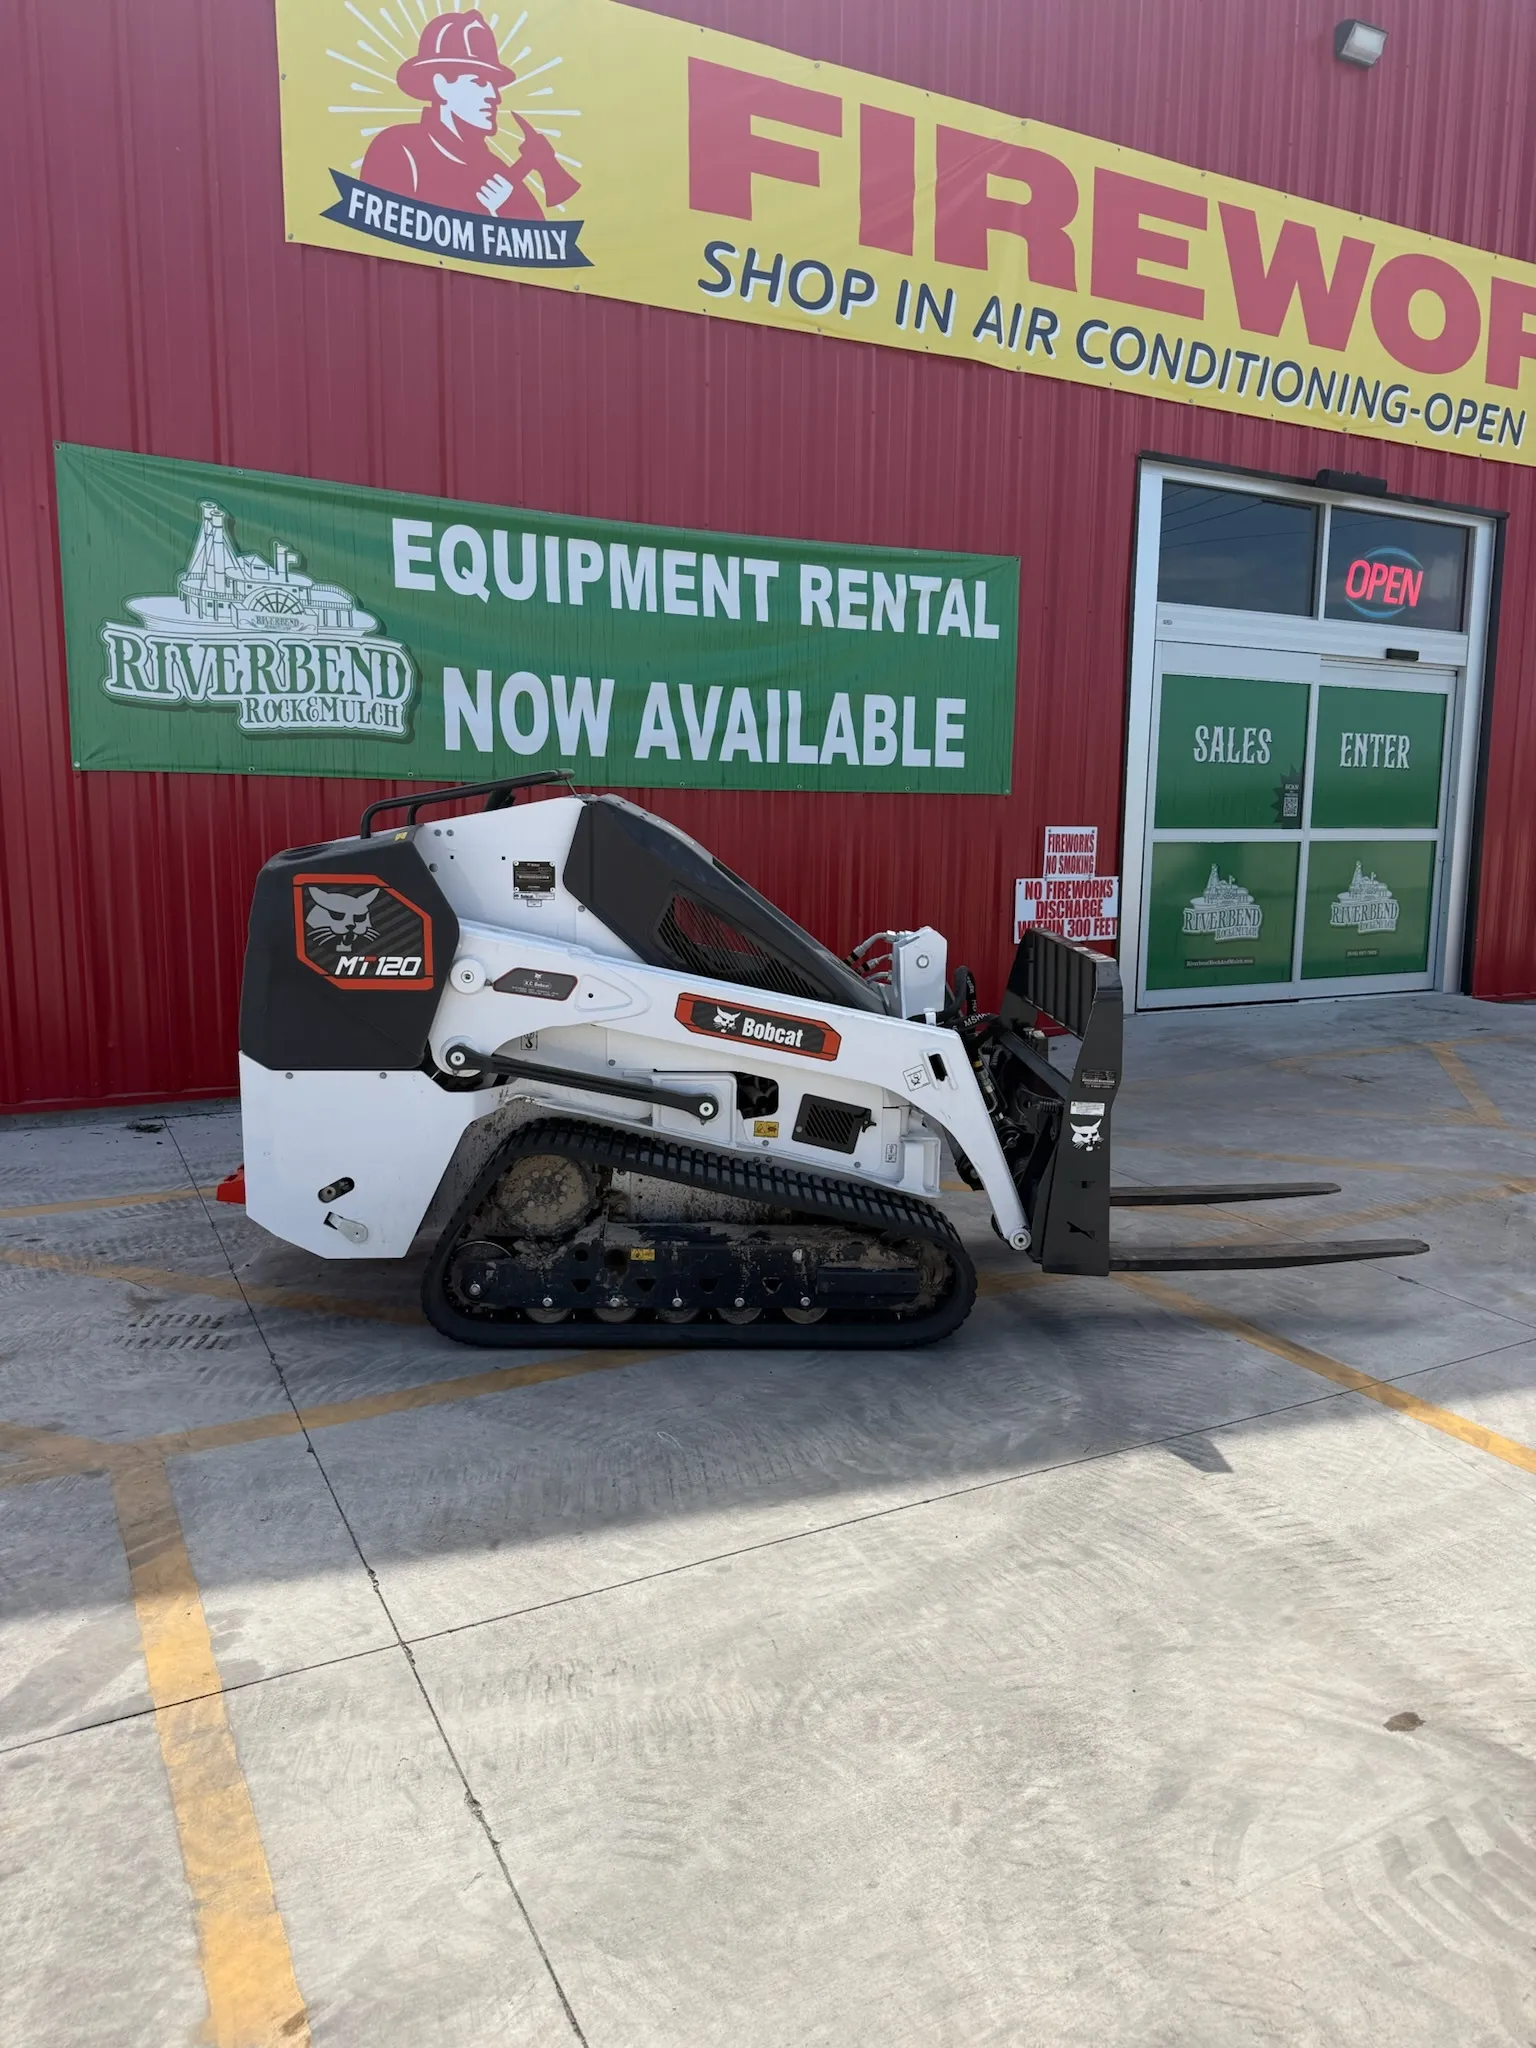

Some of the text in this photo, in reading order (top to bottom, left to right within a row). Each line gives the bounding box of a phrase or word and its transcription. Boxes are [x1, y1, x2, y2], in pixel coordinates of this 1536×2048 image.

[348, 188, 568, 261] FREEDOM FAMILY
[698, 241, 1527, 449] SHOP IN AIR CONDITIONING-OPEN
[392, 517, 1000, 640] EQUIPMENT RENTAL
[1345, 559, 1424, 607] OPEN
[108, 634, 407, 700] RIVERBEND
[443, 667, 967, 769] NOW AVAILABLE
[1193, 725, 1273, 765] SALES
[1339, 732, 1410, 769] ENTER
[1047, 833, 1095, 853] FIREWORKS
[1045, 855, 1094, 875] NO SMOKING
[1024, 879, 1113, 900] NO FIREWORKS
[1035, 899, 1103, 920] DISCHARGE
[1184, 908, 1260, 931] RIVERBEND
[1332, 902, 1398, 924] RIVERBEND
[1067, 918, 1091, 938] 300
[1093, 917, 1117, 937] FEET
[741, 1017, 804, 1048] Bobcat
